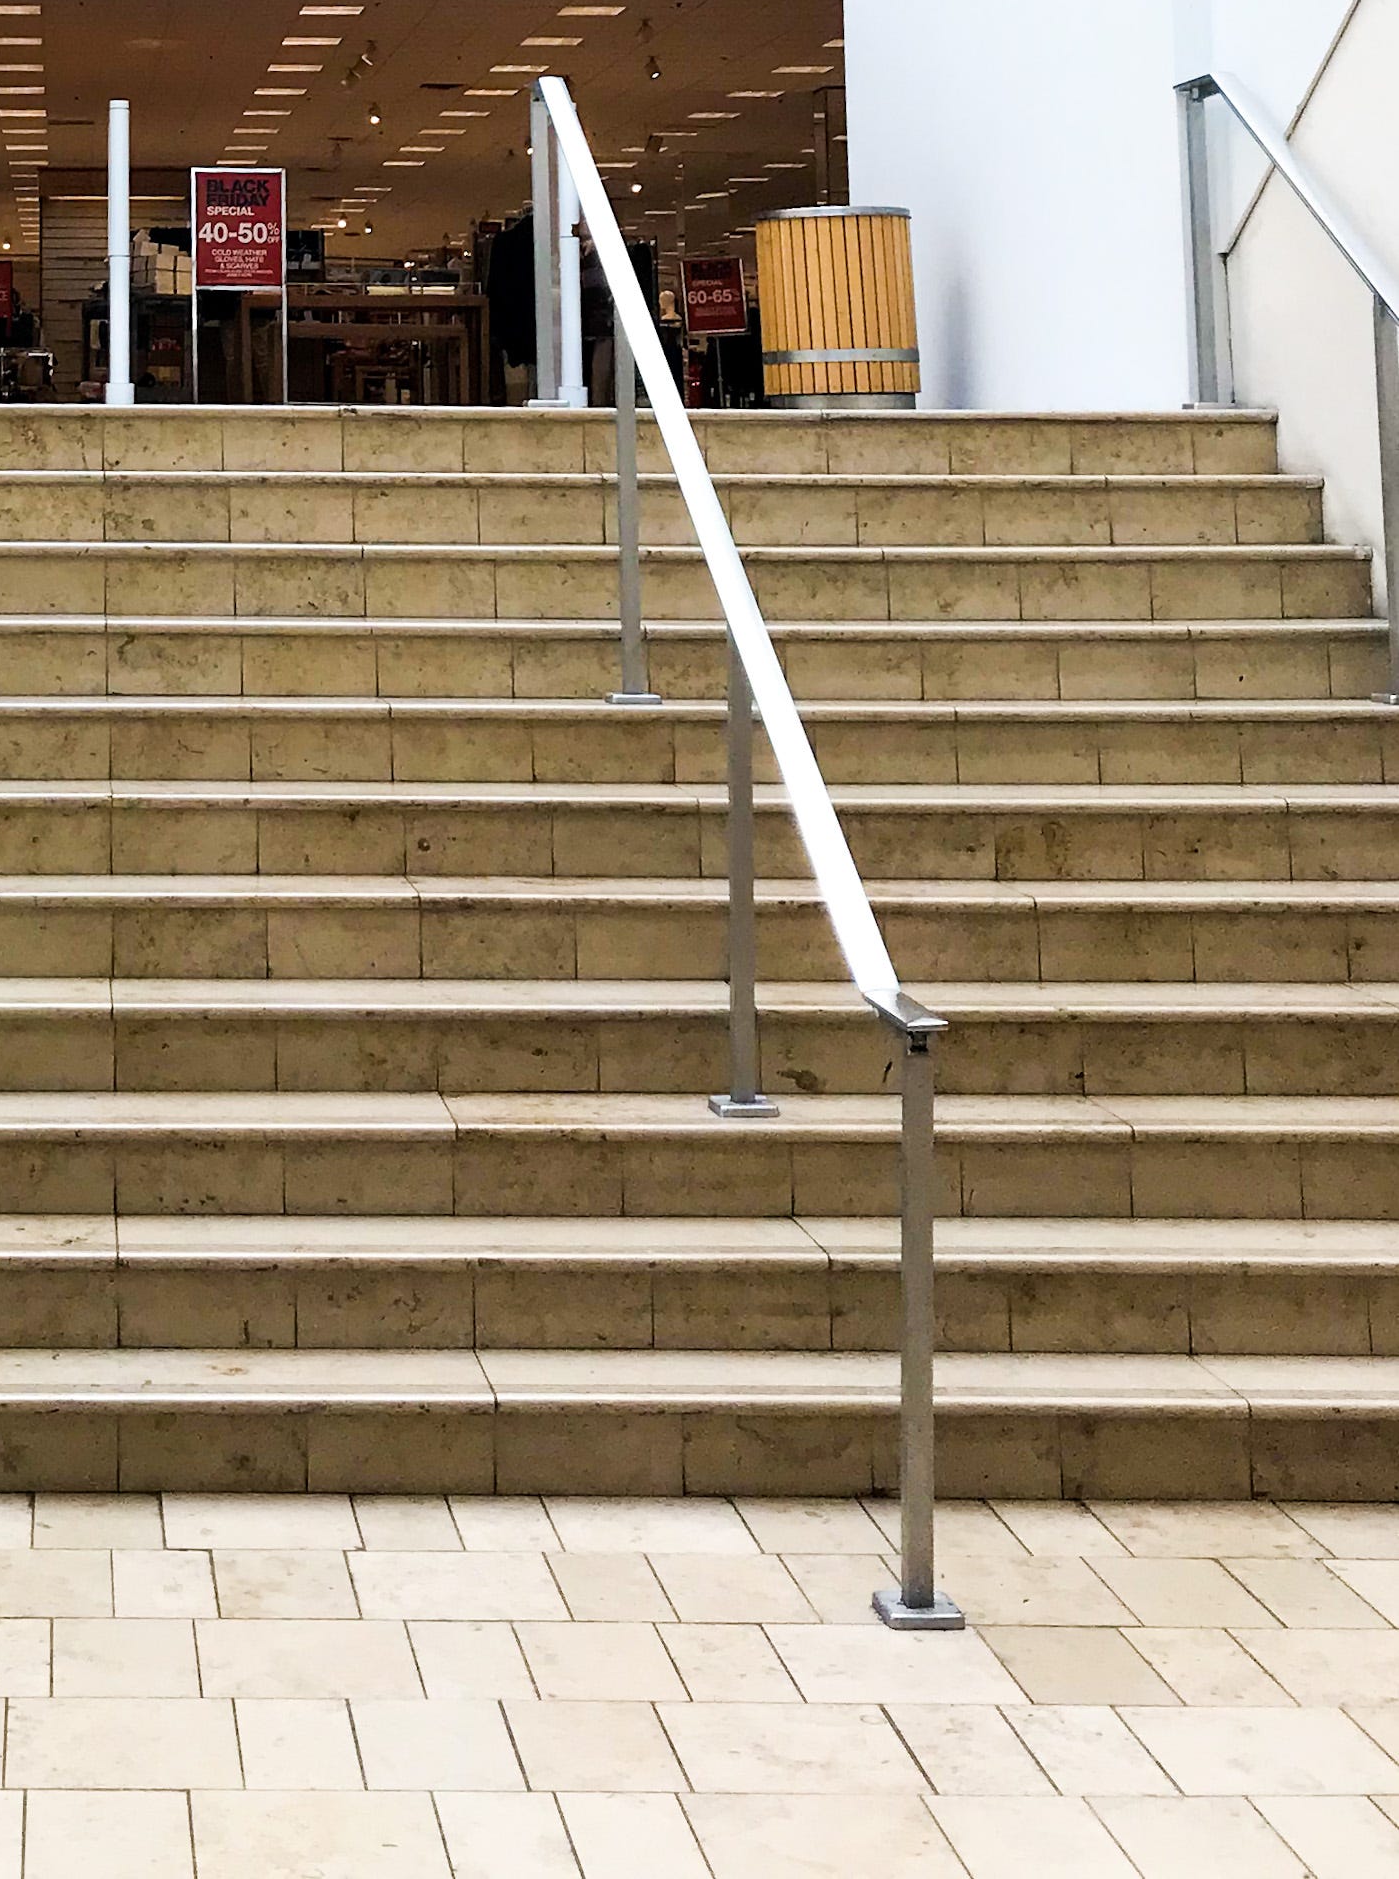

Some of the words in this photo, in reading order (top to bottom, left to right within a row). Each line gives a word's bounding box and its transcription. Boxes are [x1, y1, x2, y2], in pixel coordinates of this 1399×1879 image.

[206, 179, 270, 194] BLACK
[206, 193, 270, 207] FRIDAY
[206, 206, 255, 216] SPECIAL
